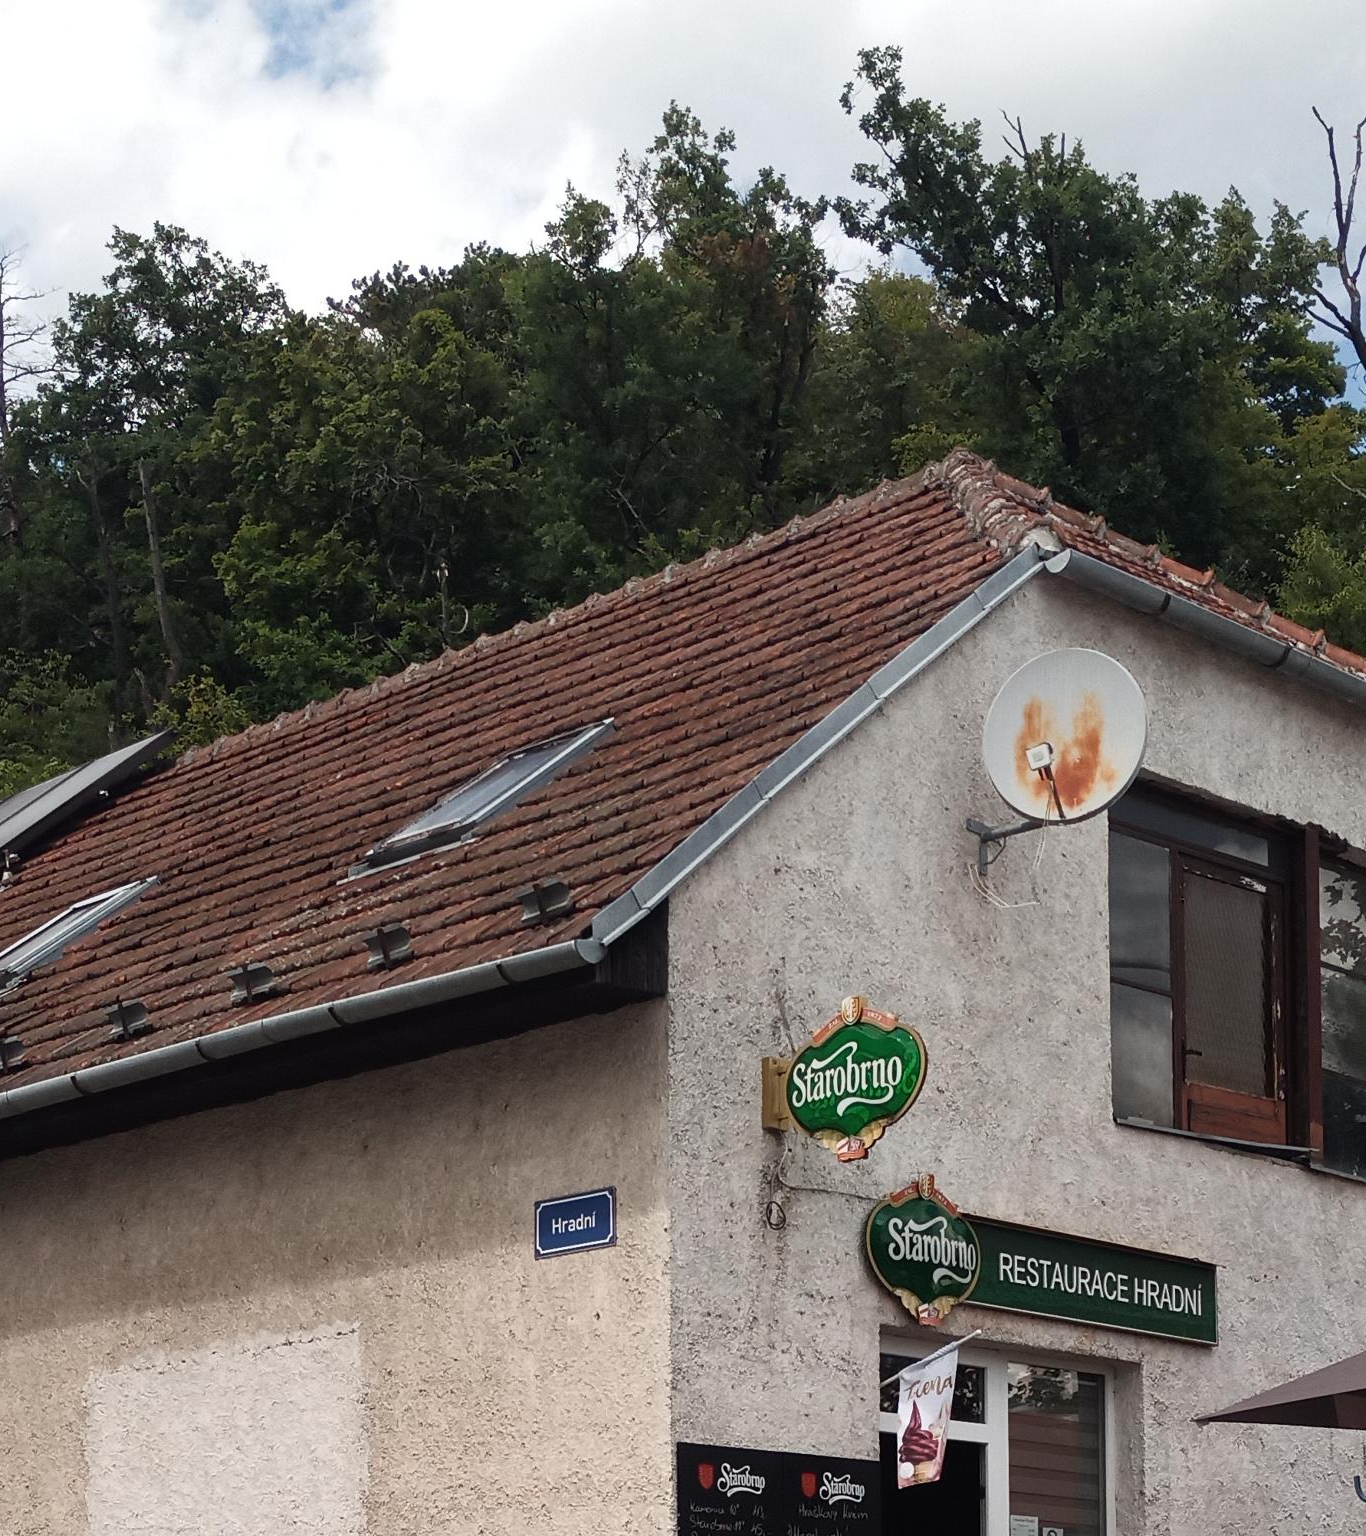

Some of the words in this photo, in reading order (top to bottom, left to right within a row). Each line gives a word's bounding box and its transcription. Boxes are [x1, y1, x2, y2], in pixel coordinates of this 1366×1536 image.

[792, 1041, 903, 1117] Starobrno
[552, 1211, 596, 1235] Hradní
[888, 1216, 977, 1285] Starobrno
[998, 1252, 1130, 1302] RESTAURACE
[1134, 1283, 1202, 1317] HRADNÍ
[717, 1462, 766, 1497] Starobrno
[819, 1472, 865, 1505] Starobrno
